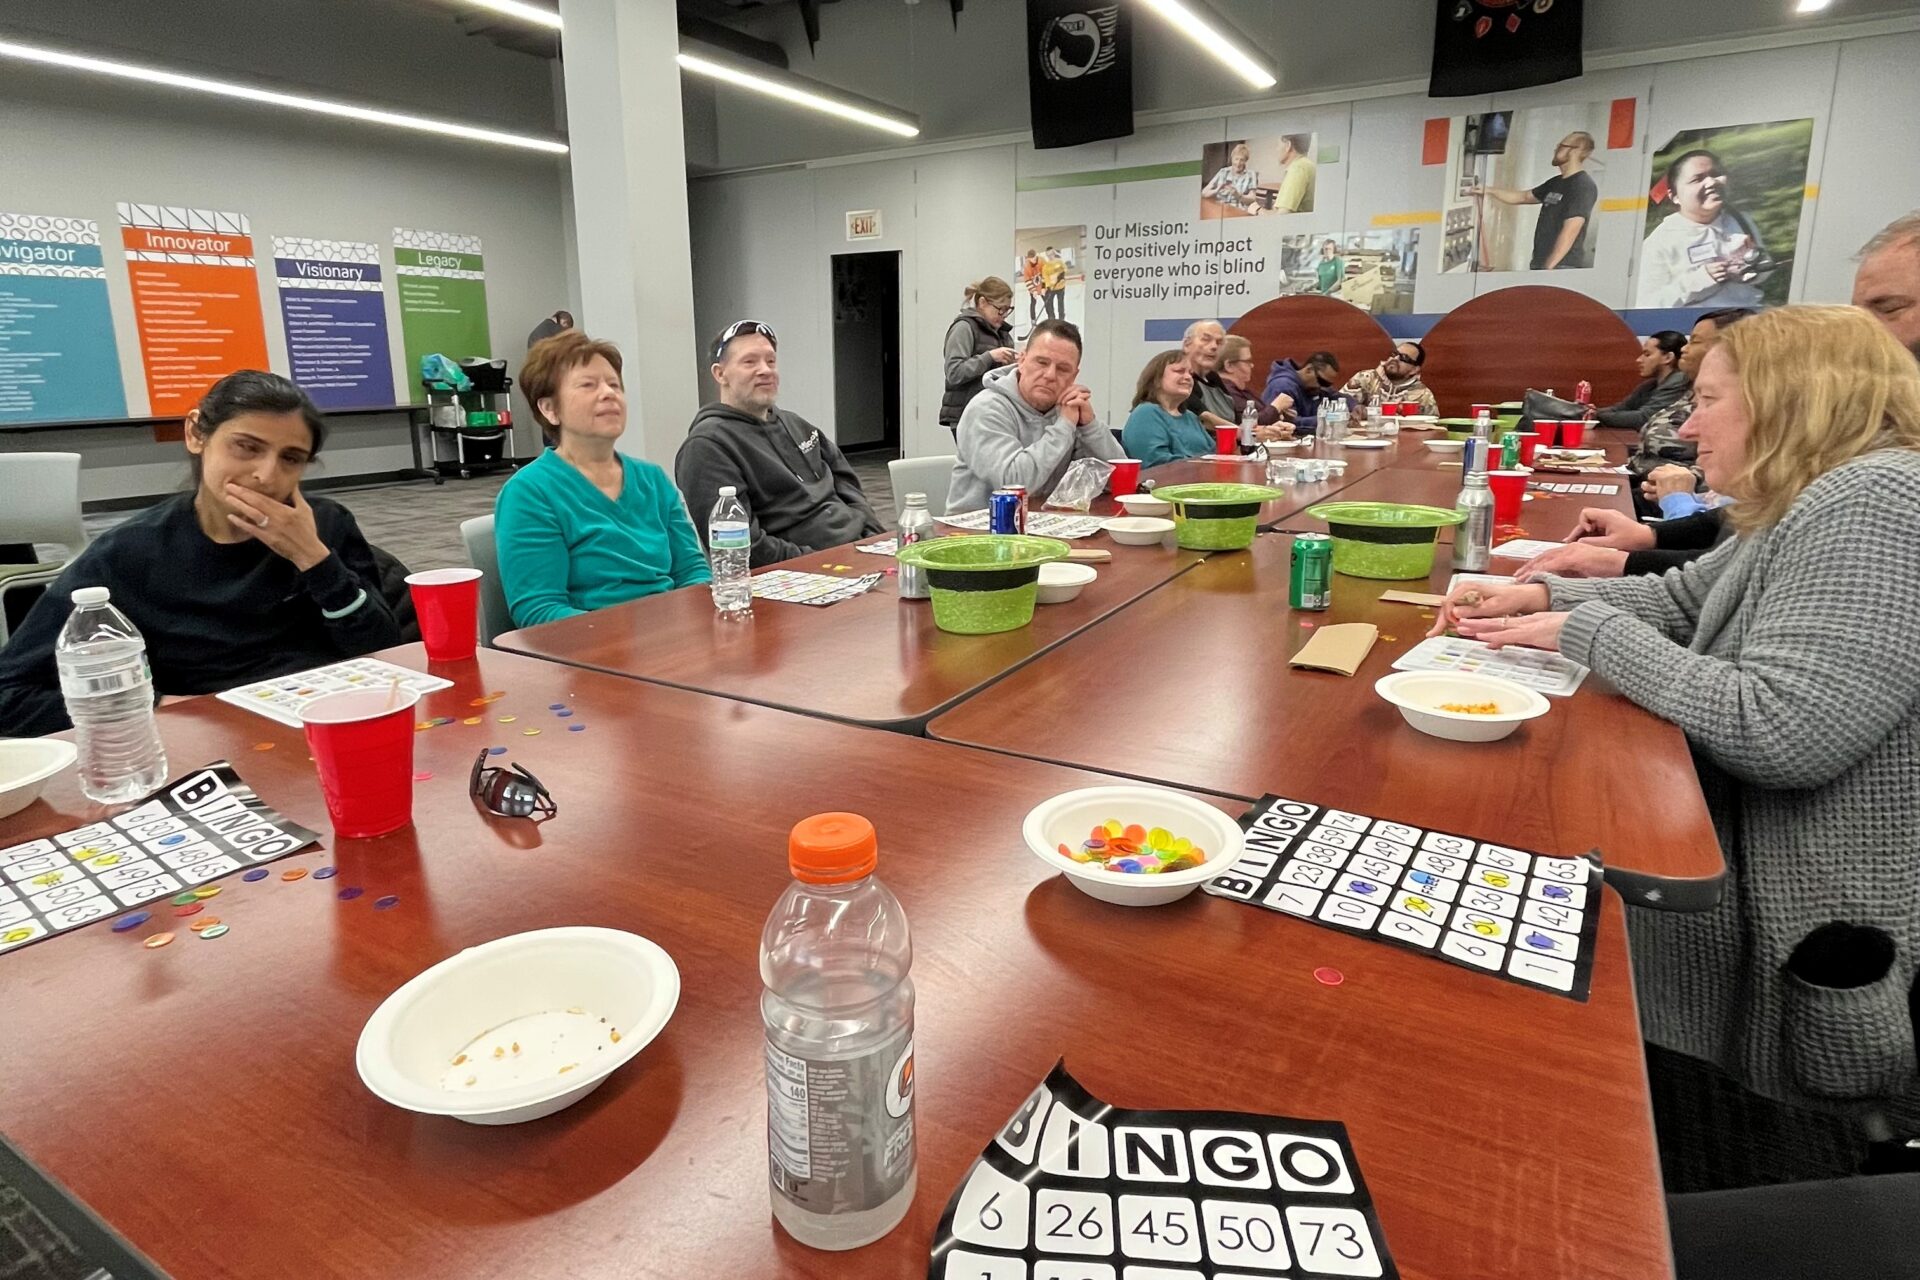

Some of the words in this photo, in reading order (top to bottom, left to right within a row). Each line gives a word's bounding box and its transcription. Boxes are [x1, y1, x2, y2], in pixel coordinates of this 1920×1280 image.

[855, 215, 873, 234] EXIT
[1095, 225, 1121, 240] Our
[1125, 221, 1189, 238] Mission:
[146, 231, 231, 252] Innovator
[1094, 245, 1112, 260] To
[1115, 241, 1190, 262] positively
[1194, 237, 1253, 257] impact
[0, 242, 76, 263] vigator
[418, 252, 462, 269] Legacy
[296, 261, 363, 281] Visionary
[1094, 265, 1164, 281] everyone
[1168, 262, 1200, 277] who
[1205, 260, 1219, 275] is
[1223, 257, 1265, 274] blind
[1093, 288, 1108, 300] or
[1112, 283, 1170, 300] visually
[1173, 280, 1251, 299] impaired.
[128, 813, 156, 823] 6
[178, 776, 292, 856] BINGO
[1332, 814, 1360, 830] 74
[71, 827, 102, 842] 10
[141, 821, 175, 837] 30
[1320, 829, 1348, 845] 59
[1382, 825, 1410, 842] 73
[5, 844, 41, 861] 12
[1211, 803, 1311, 895] BINGO
[1306, 846, 1337, 865] 38
[1374, 841, 1400, 858] 49
[1436, 837, 1463, 855] 63
[18, 857, 55, 873] 27
[178, 850, 209, 864] 48
[1425, 856, 1455, 874] 48
[1487, 848, 1516, 867] 67
[114, 867, 149, 882] 49
[192, 862, 228, 878] 65
[1292, 864, 1324, 885] 23
[1361, 858, 1390, 879] 45
[1547, 861, 1577, 880] 65
[46, 886, 85, 905] 50
[128, 879, 168, 898] 75
[1278, 892, 1305, 906] 7
[1404, 896, 1436, 919] 29
[1471, 889, 1504, 911] 36
[62, 904, 102, 923] 63
[1333, 901, 1366, 922] 10
[1538, 905, 1569, 927] 42
[1395, 922, 1424, 937] 9
[1456, 942, 1486, 957] 6
[1524, 962, 1559, 974] 1
[790, 1086, 806, 1099] 140
[1003, 1091, 1341, 1186] BINGO
[979, 1192, 1003, 1231] 6
[1046, 1203, 1104, 1240] 26
[1132, 1209, 1190, 1246] 45
[1218, 1215, 1276, 1254] 50
[1298, 1221, 1365, 1260] 73
